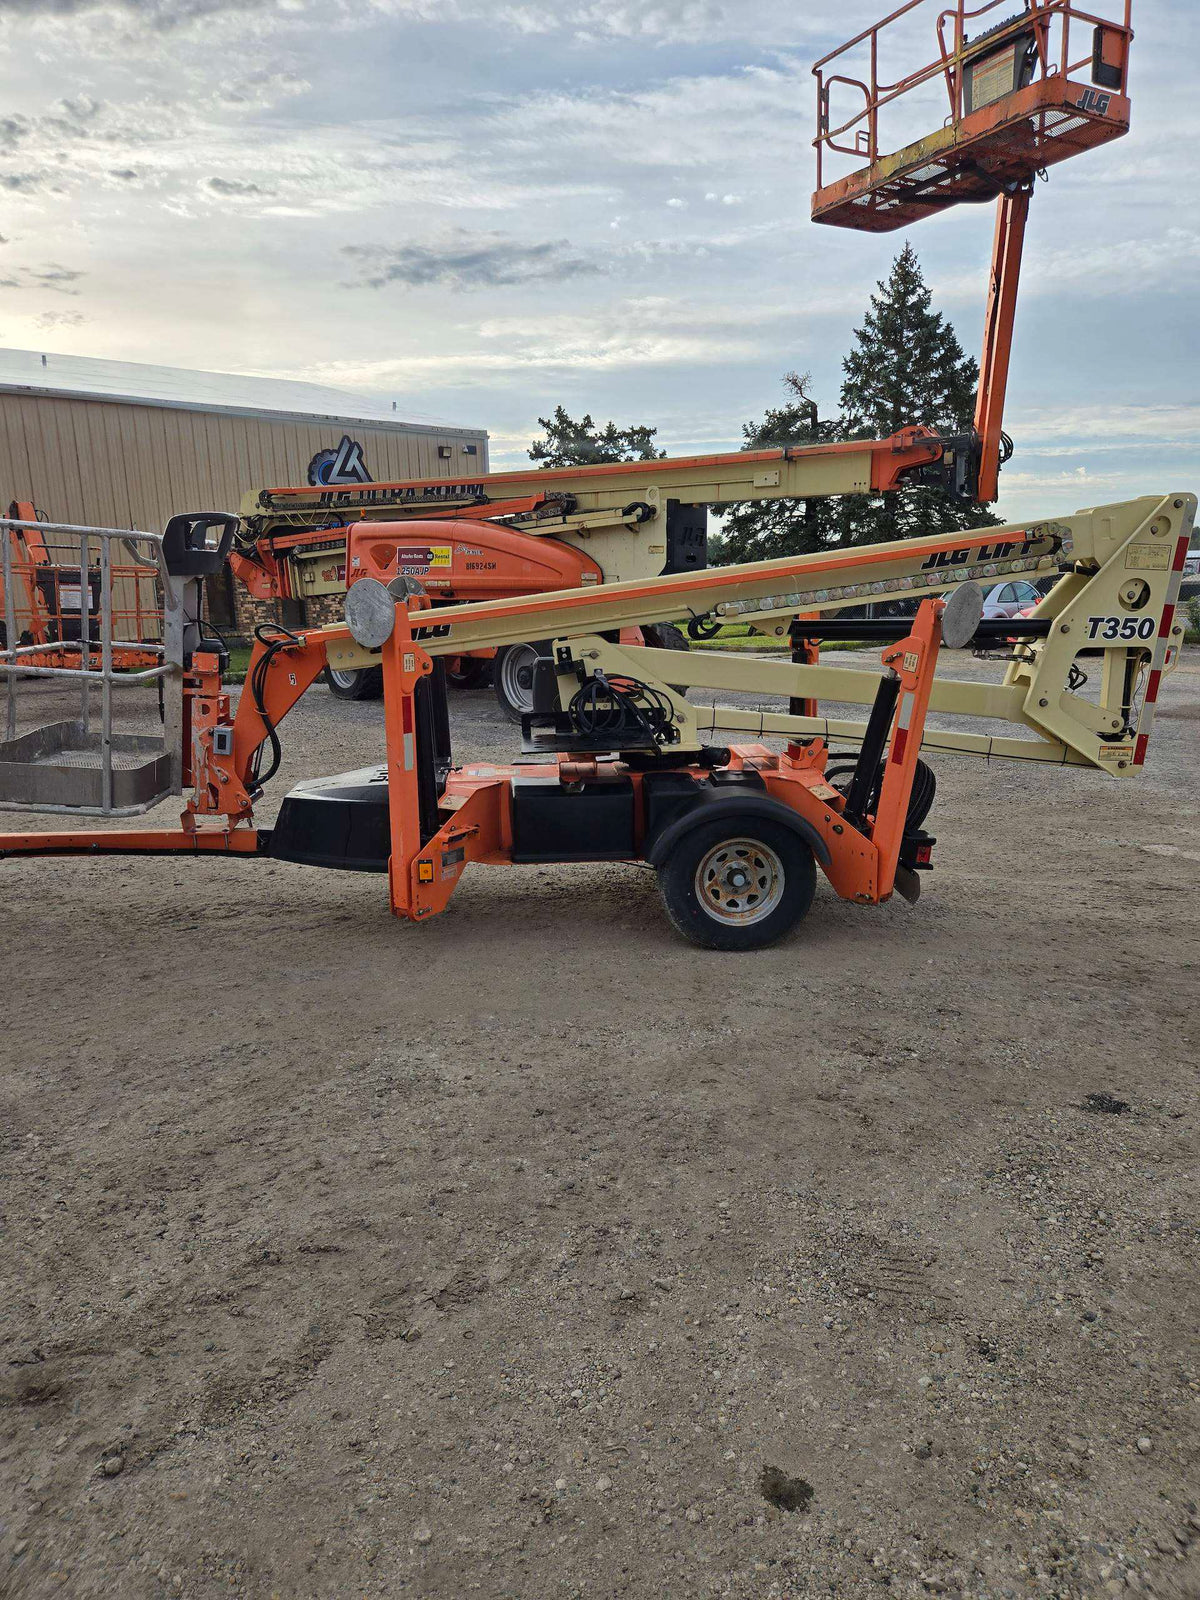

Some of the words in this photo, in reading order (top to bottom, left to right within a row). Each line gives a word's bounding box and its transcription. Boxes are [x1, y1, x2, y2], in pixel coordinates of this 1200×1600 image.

[1076, 88, 1111, 115] JLG
[921, 547, 970, 570] JLG
[977, 540, 1034, 562] LIFT
[397, 566, 430, 576] 1250AJP
[1088, 616, 1156, 640] T350
